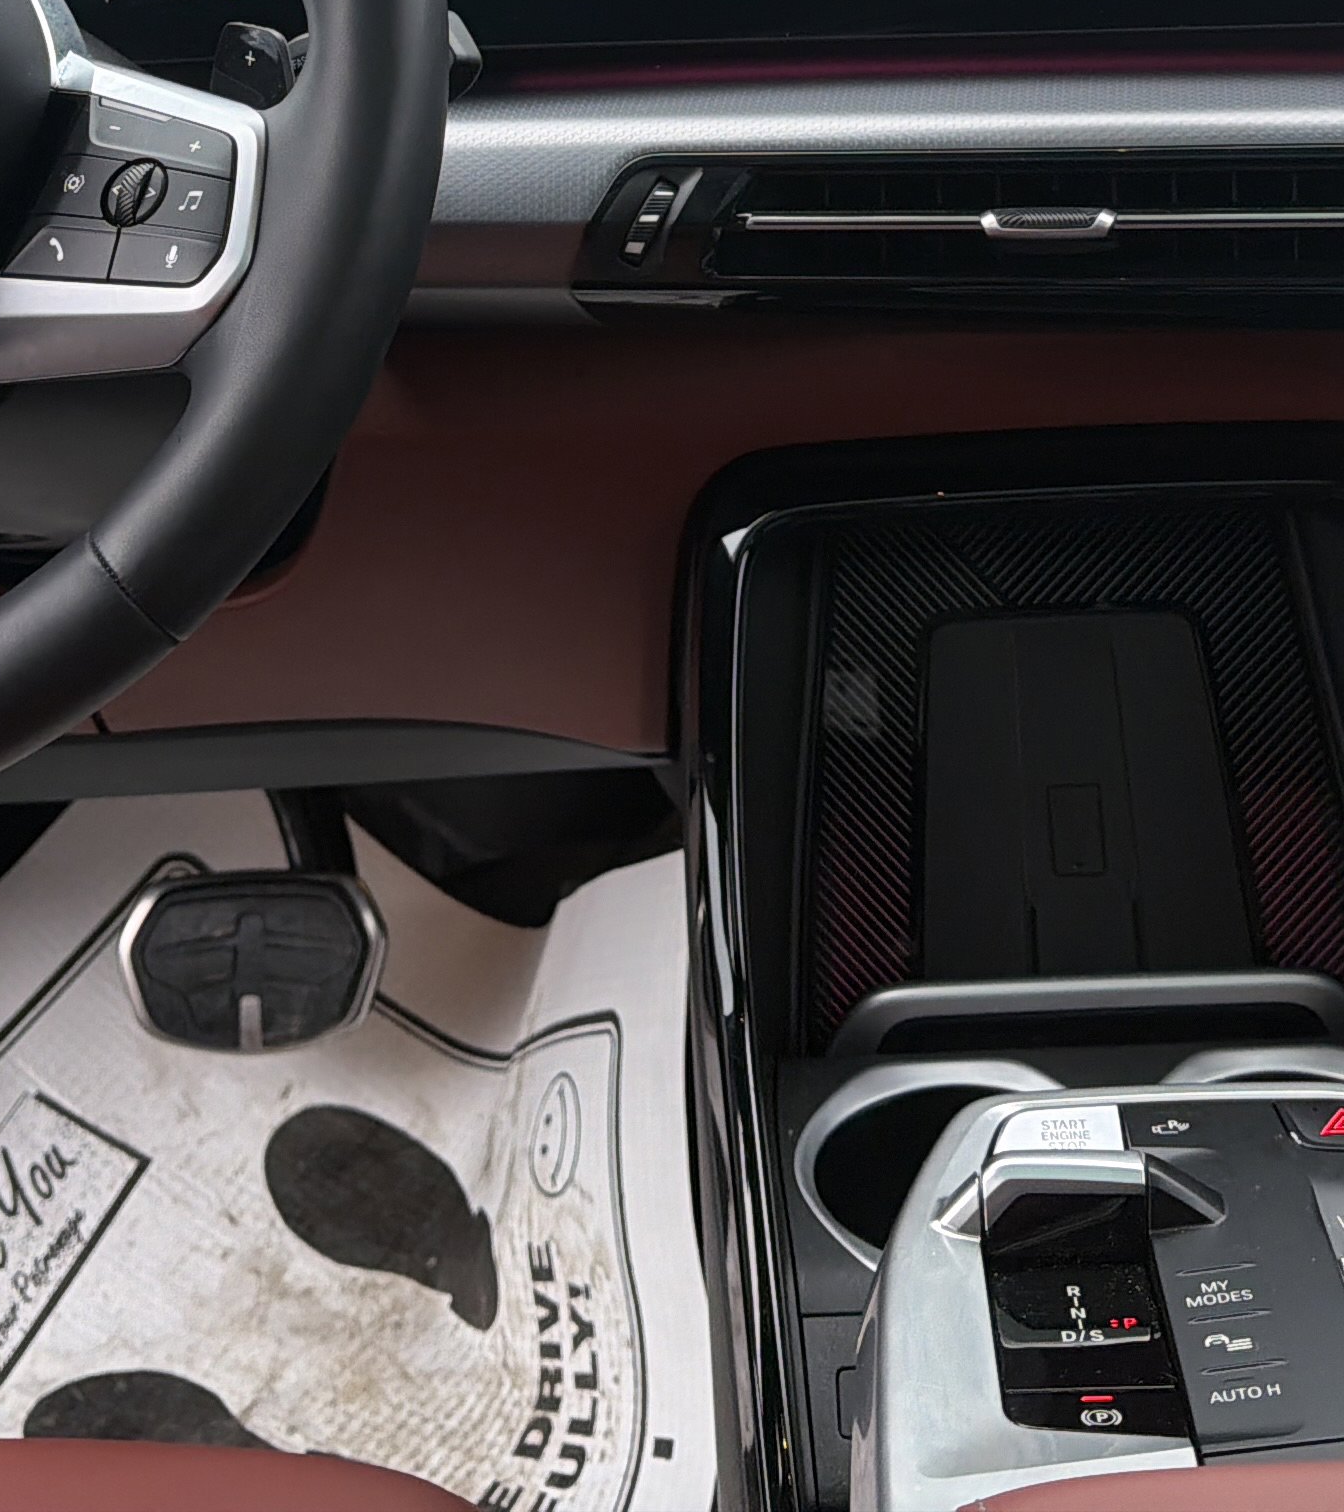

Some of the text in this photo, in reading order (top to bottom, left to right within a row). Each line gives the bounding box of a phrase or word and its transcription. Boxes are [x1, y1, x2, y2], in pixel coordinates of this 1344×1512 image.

[1041, 1119, 1088, 1130] START
[1041, 1130, 1092, 1141] ENGINE
[1066, 1285, 1081, 1297] R
[1200, 1279, 1229, 1293] MY
[1185, 1289, 1254, 1308] MODES
[1070, 1307, 1087, 1319] N
[512, 1240, 563, 1461] DRIVE
[1210, 1383, 1282, 1404] AUTO H
